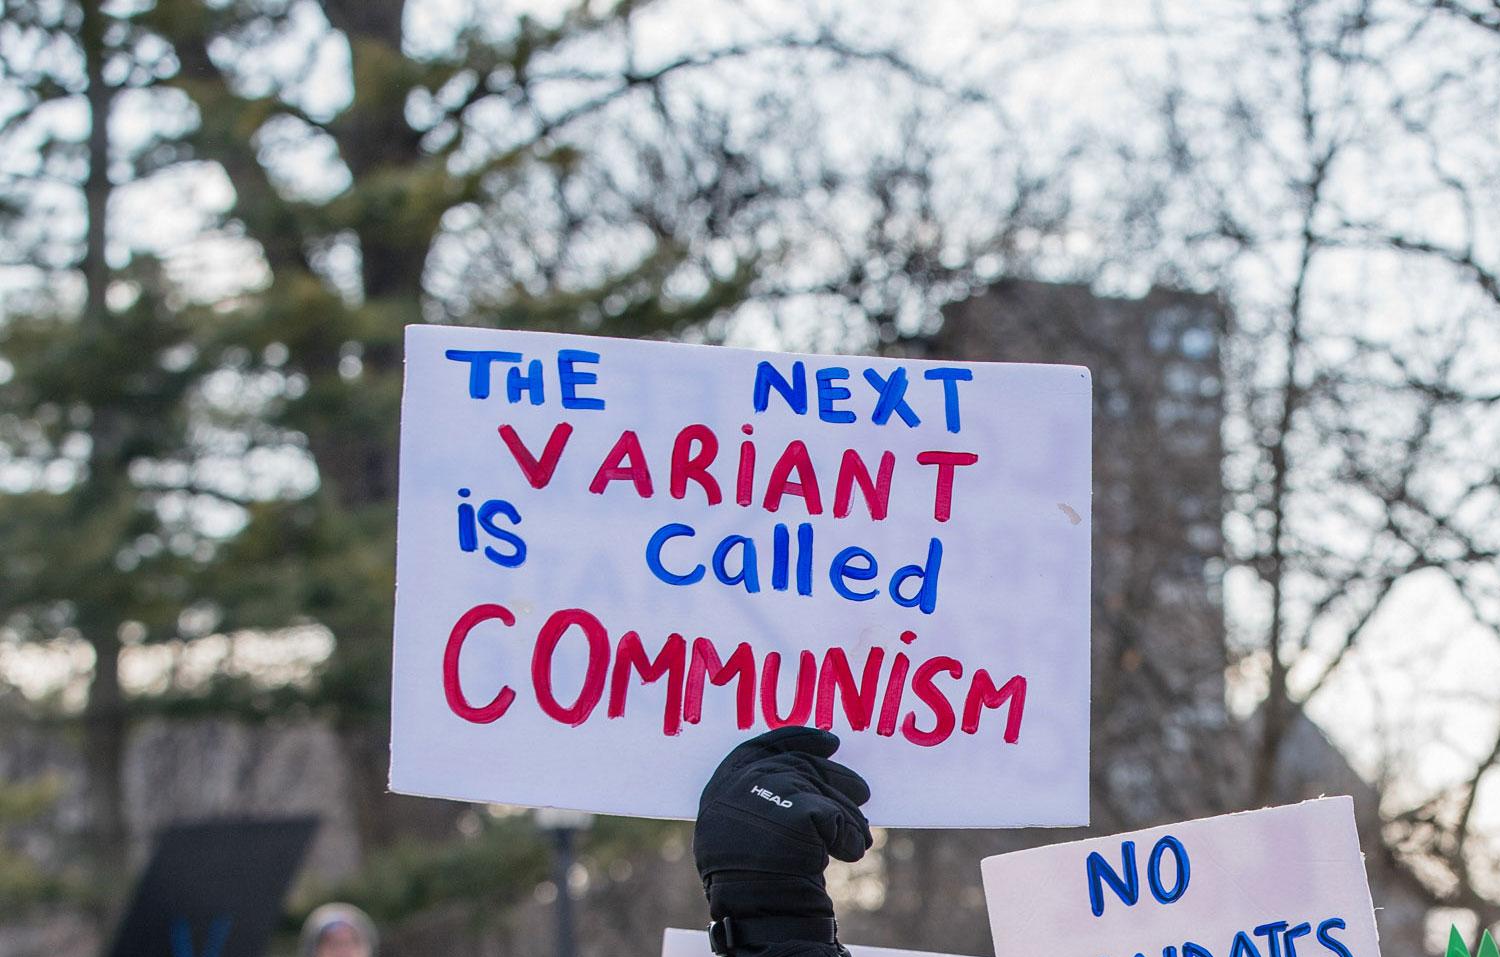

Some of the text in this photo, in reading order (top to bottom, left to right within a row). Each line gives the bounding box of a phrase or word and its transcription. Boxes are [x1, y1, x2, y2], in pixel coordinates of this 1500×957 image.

[445, 349, 974, 433] THE NEXT
[750, 785, 793, 809] HEAD
[1086, 835, 1191, 917] NO
